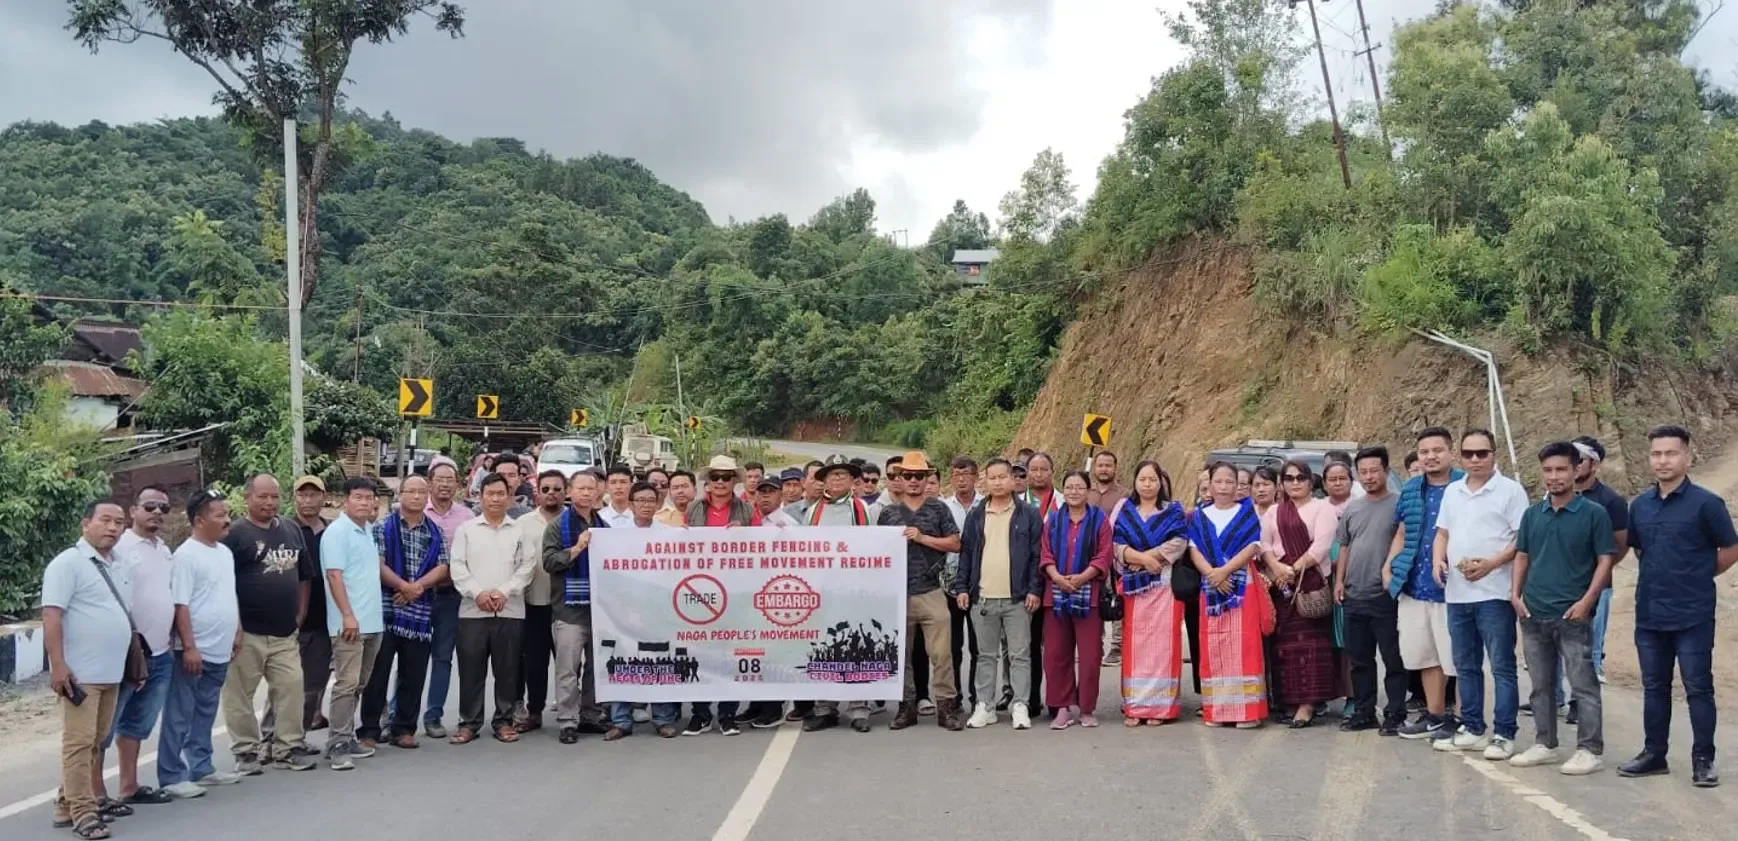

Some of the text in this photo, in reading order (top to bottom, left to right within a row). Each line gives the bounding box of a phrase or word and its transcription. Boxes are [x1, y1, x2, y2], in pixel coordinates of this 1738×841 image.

[645, 541, 848, 554] AGAINST BORDER FENCING &
[603, 556, 892, 571] ABROGATION OF FREE MOVEMENT REGIME
[683, 593, 718, 605] TRADE
[756, 594, 818, 608] EMBARGO
[677, 629, 820, 641] NAGA PEOPLE'S MOVEMENT
[738, 658, 761, 673] 08
[861, 661, 892, 671] NAGA
